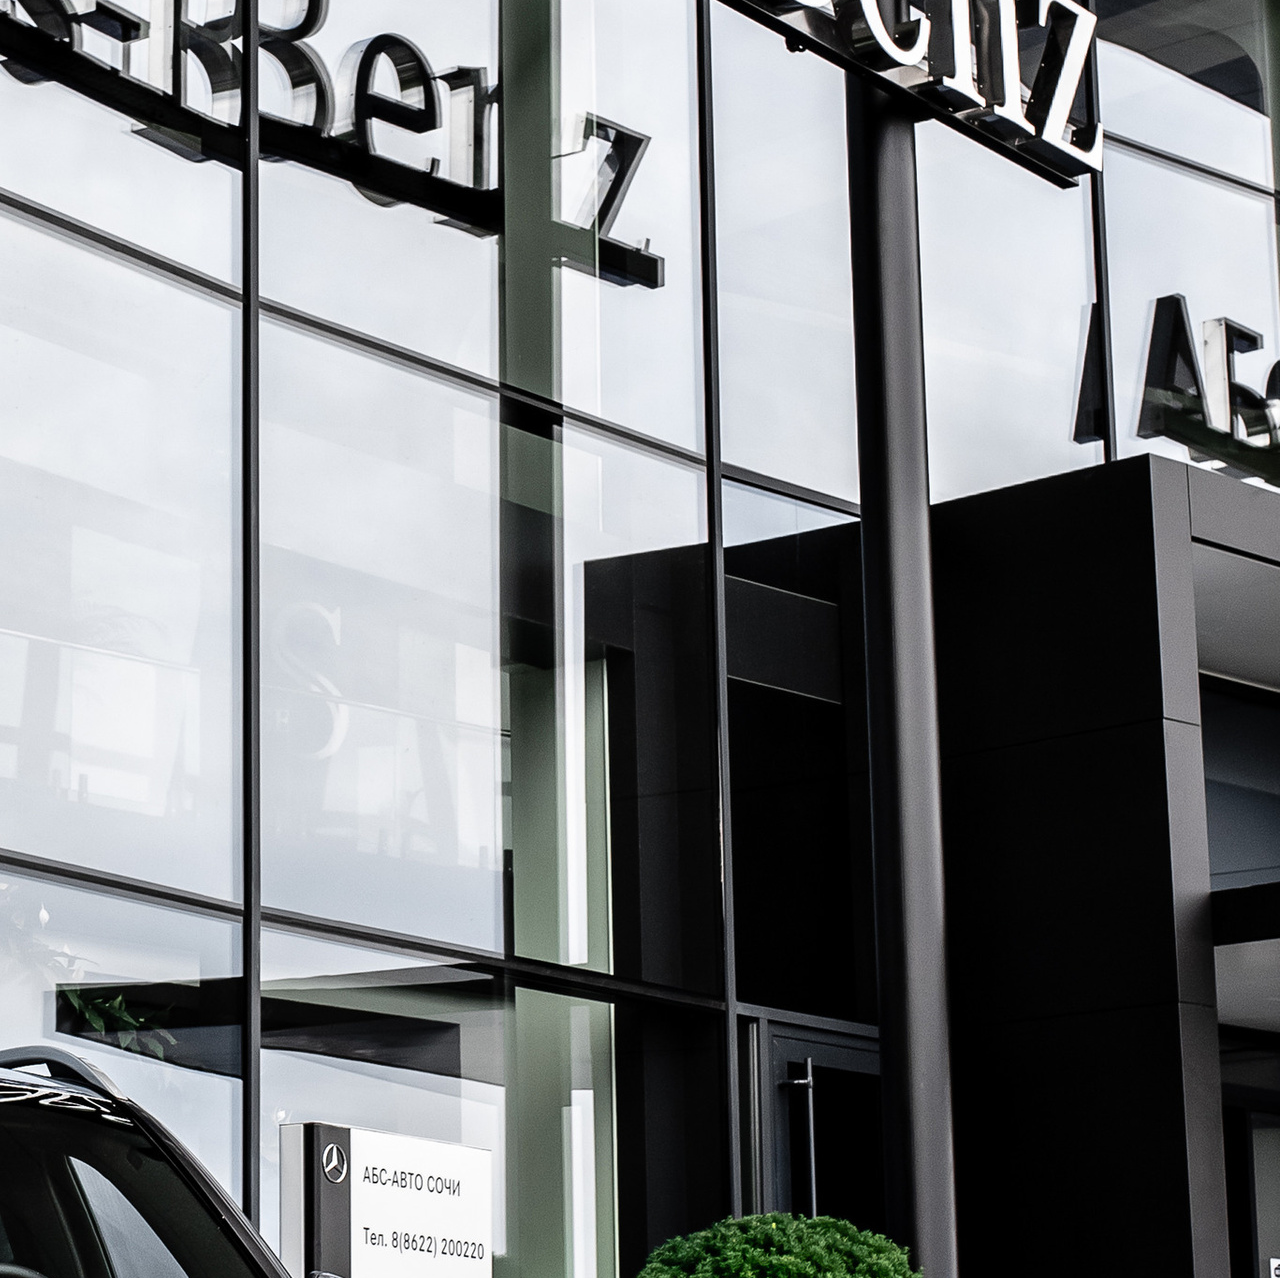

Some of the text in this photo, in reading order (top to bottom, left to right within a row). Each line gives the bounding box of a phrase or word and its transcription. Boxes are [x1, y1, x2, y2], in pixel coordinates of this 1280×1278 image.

[362, 1165, 462, 1197] АБС-АВТО СОЧИ
[362, 1226, 485, 1260] Тел. 8(8622) 200220
